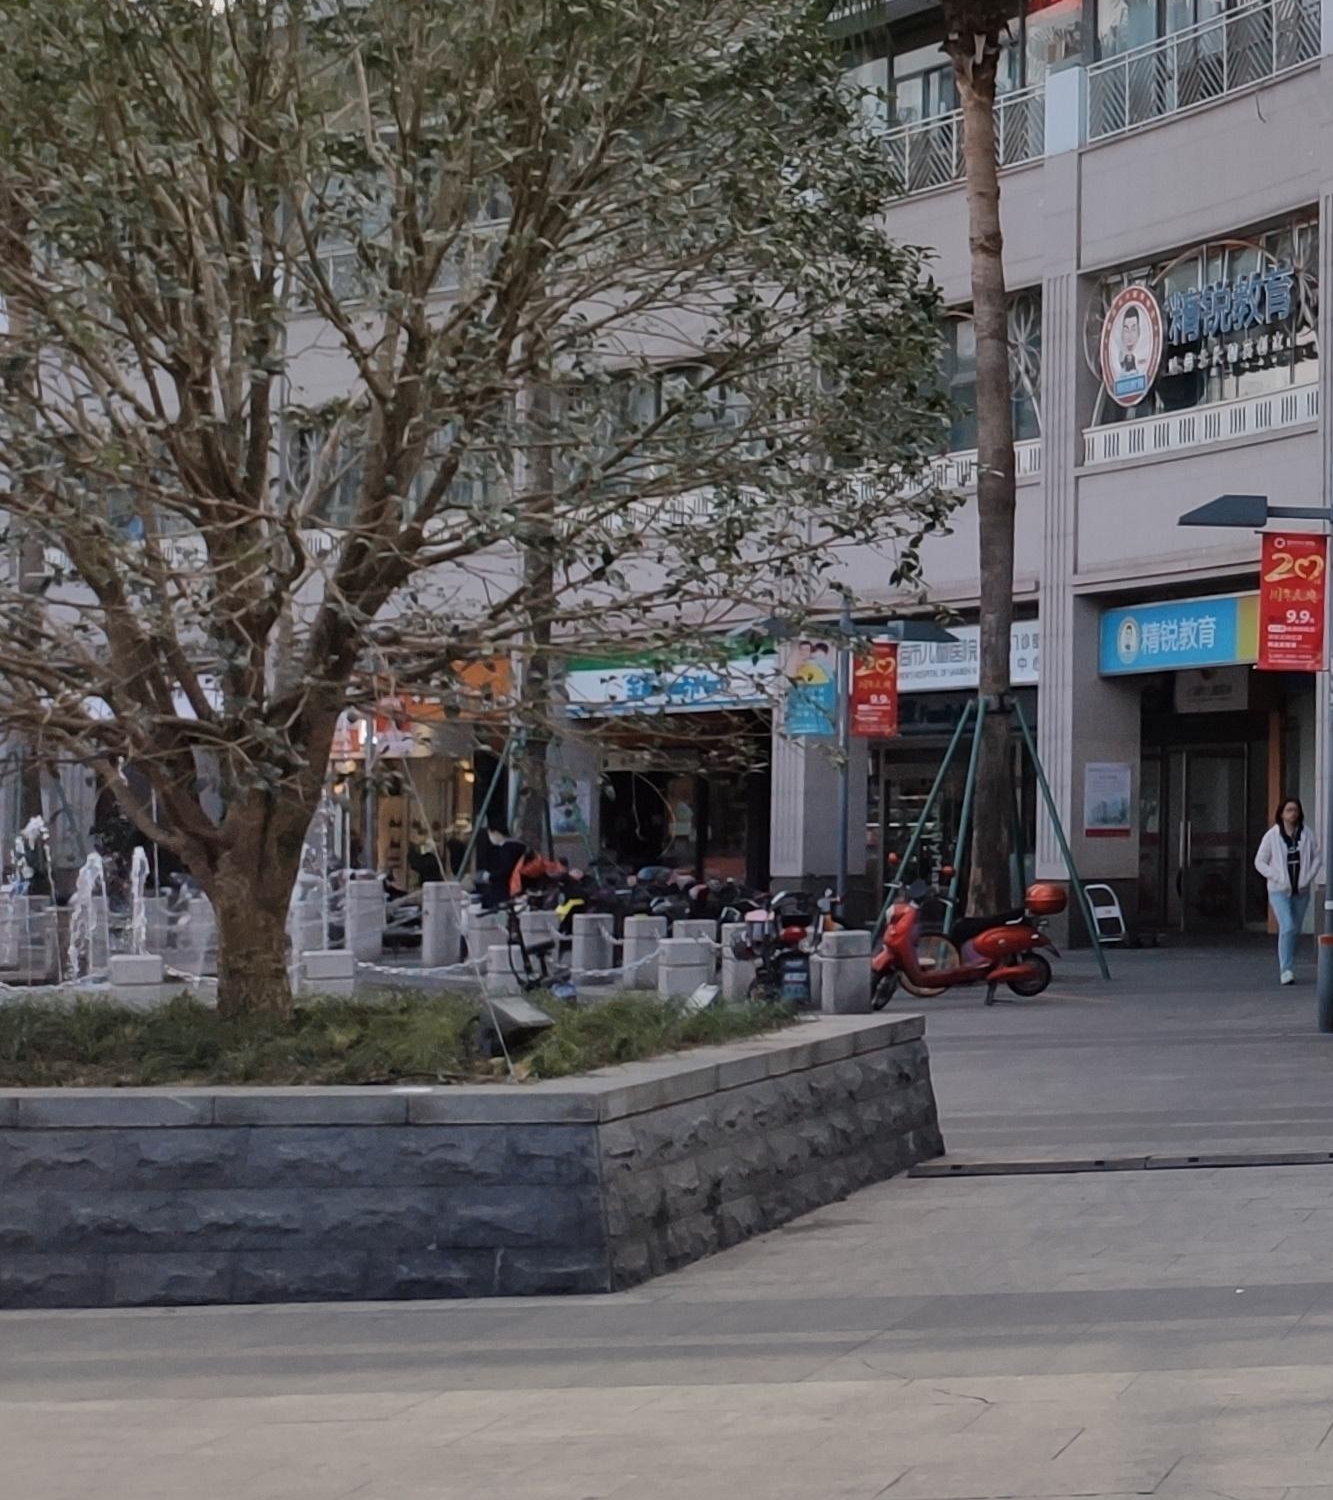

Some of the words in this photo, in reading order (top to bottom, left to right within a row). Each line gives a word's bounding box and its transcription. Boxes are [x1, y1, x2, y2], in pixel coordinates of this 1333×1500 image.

[1168, 265, 1294, 346] 精锐教育
[1141, 613, 1217, 657] 精锐教育
